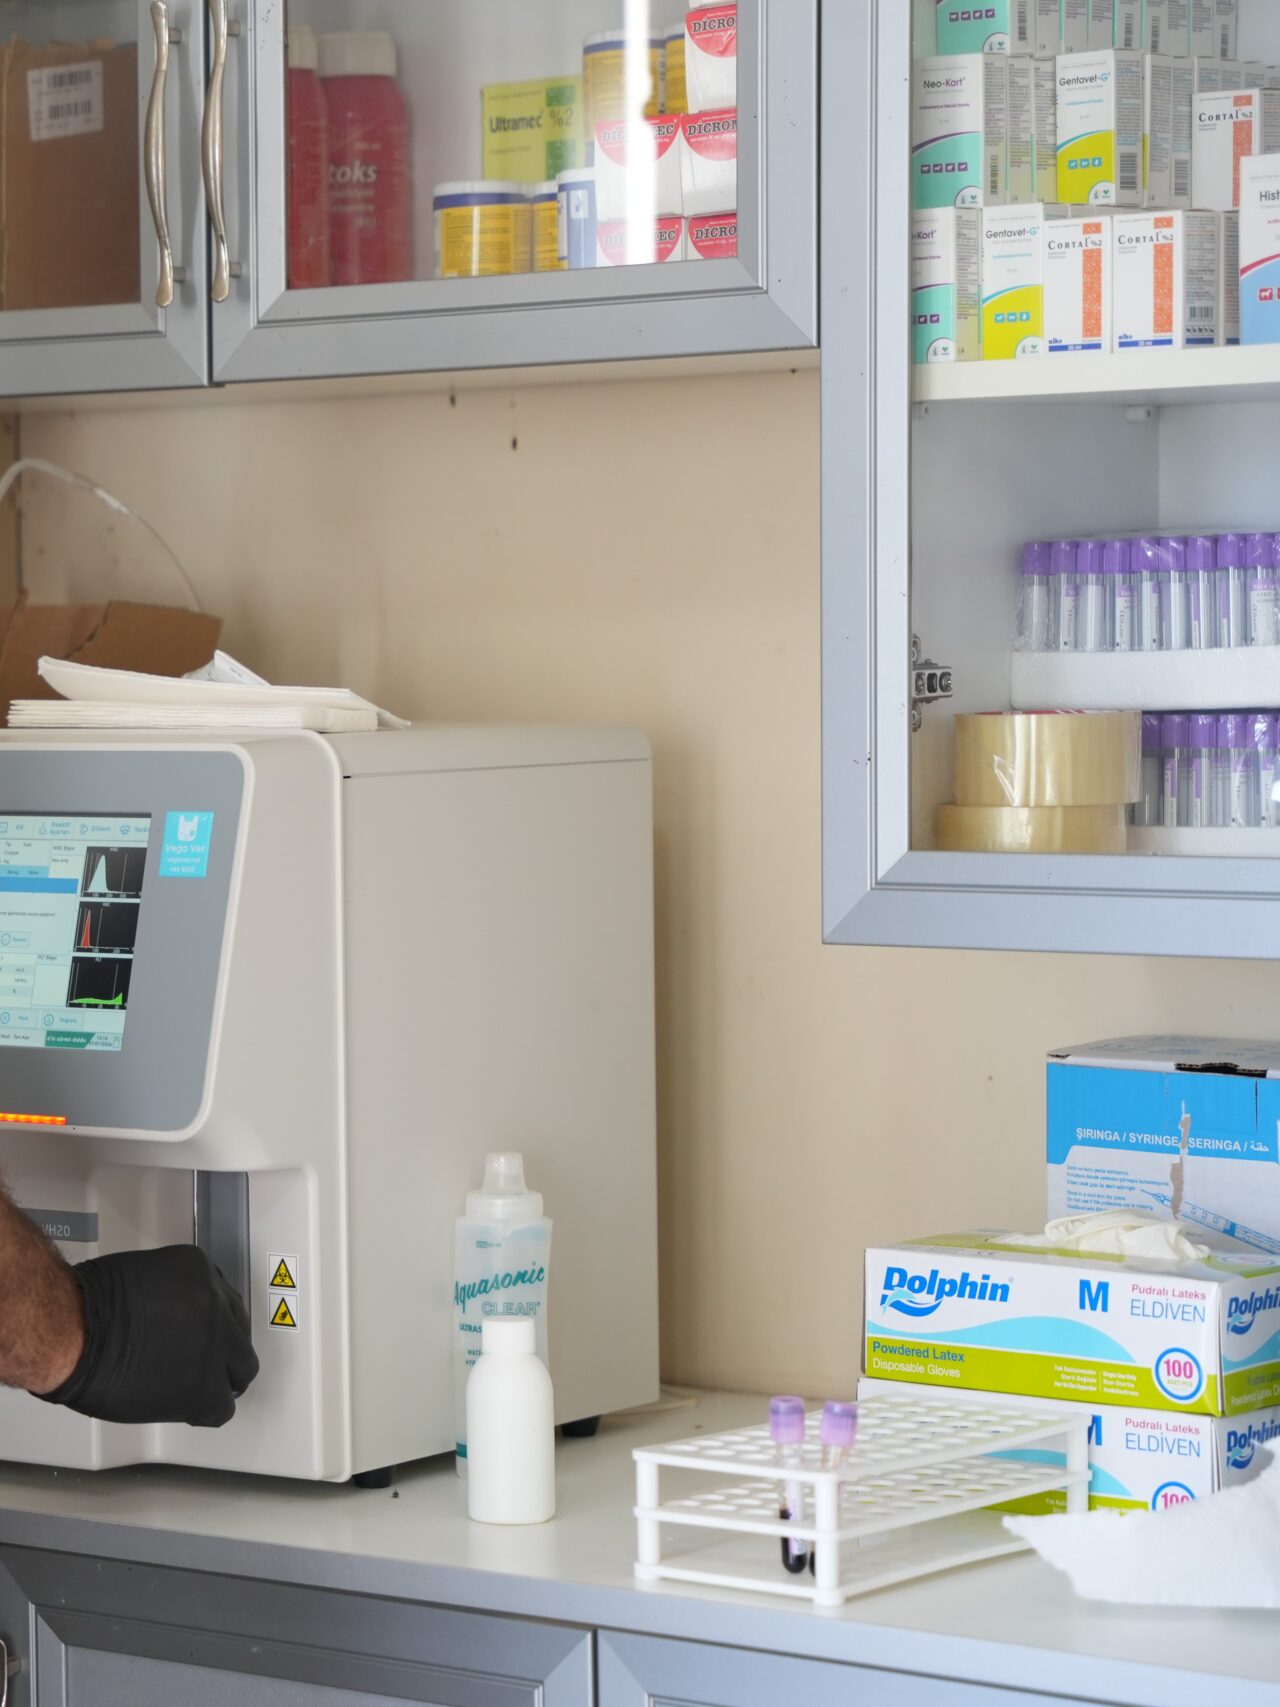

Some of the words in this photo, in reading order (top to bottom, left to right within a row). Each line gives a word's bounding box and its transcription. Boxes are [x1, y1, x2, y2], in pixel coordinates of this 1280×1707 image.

[923, 78, 963, 89] Neo-Kort
[1059, 73, 1109, 87] Gentavet-G
[489, 114, 542, 133] Ultramec
[912, 230, 934, 241] -Kort
[985, 226, 1038, 239] Gentavet-G
[1129, 1133, 1178, 1147] SYRINGE
[1188, 1137, 1241, 1151] SERINGA
[880, 1266, 1010, 1307] Dolphin
[1131, 1283, 1169, 1297] Pudralı
[1172, 1287, 1207, 1300] Lateks
[1079, 1279, 1110, 1313] M
[1228, 1287, 1280, 1320] Dolphi
[481, 1300, 538, 1317] CLEAR
[1130, 1298, 1206, 1323] ELDİVEN
[459, 1322, 482, 1334] ULTRAS
[872, 1341, 930, 1359] Powdered
[933, 1348, 965, 1362] Latex
[873, 1358, 925, 1374] Disposable
[927, 1364, 961, 1378] Gloves
[1163, 1359, 1194, 1380] 100
[1125, 1417, 1163, 1432] Pudralı
[1166, 1423, 1201, 1435] Lateks
[1125, 1433, 1200, 1458] ELDİVEN
